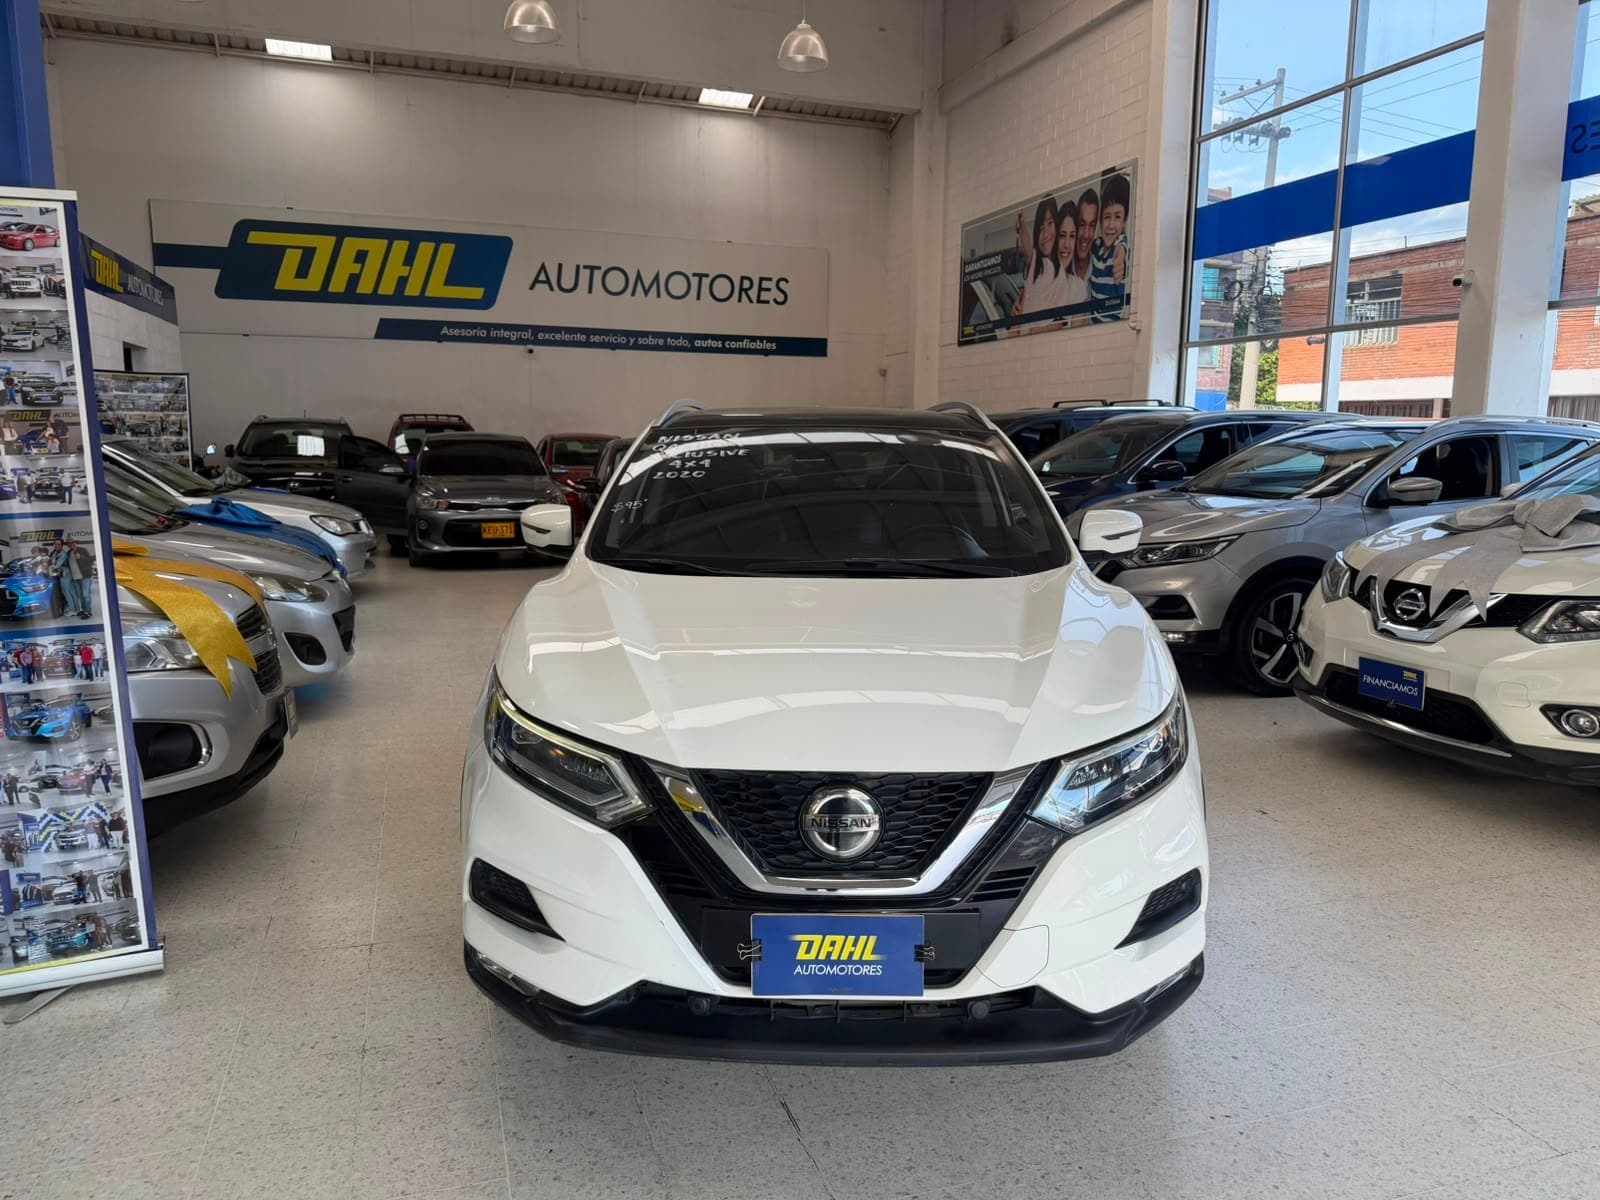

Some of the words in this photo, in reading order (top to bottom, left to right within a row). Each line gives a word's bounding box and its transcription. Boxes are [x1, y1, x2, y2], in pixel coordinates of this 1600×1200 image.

[91, 249, 124, 293] DAHL
[247, 231, 485, 299] DAHL
[529, 261, 789, 305] AUTOMOTORES
[490, 327, 534, 341] integral,
[537, 330, 587, 342] excelente
[589, 333, 627, 344] servicio
[628, 336, 636, 346] y
[638, 335, 665, 345] sobre
[667, 336, 691, 348] todo,
[694, 338, 723, 348] autos
[725, 338, 777, 350] confiables
[652, 470, 706, 479] 2020
[1363, 674, 1418, 696] FINANCIAMOS
[811, 818, 871, 828] NISSAN
[790, 934, 886, 961] DAHL
[793, 964, 882, 976] AUTOMOTORES
